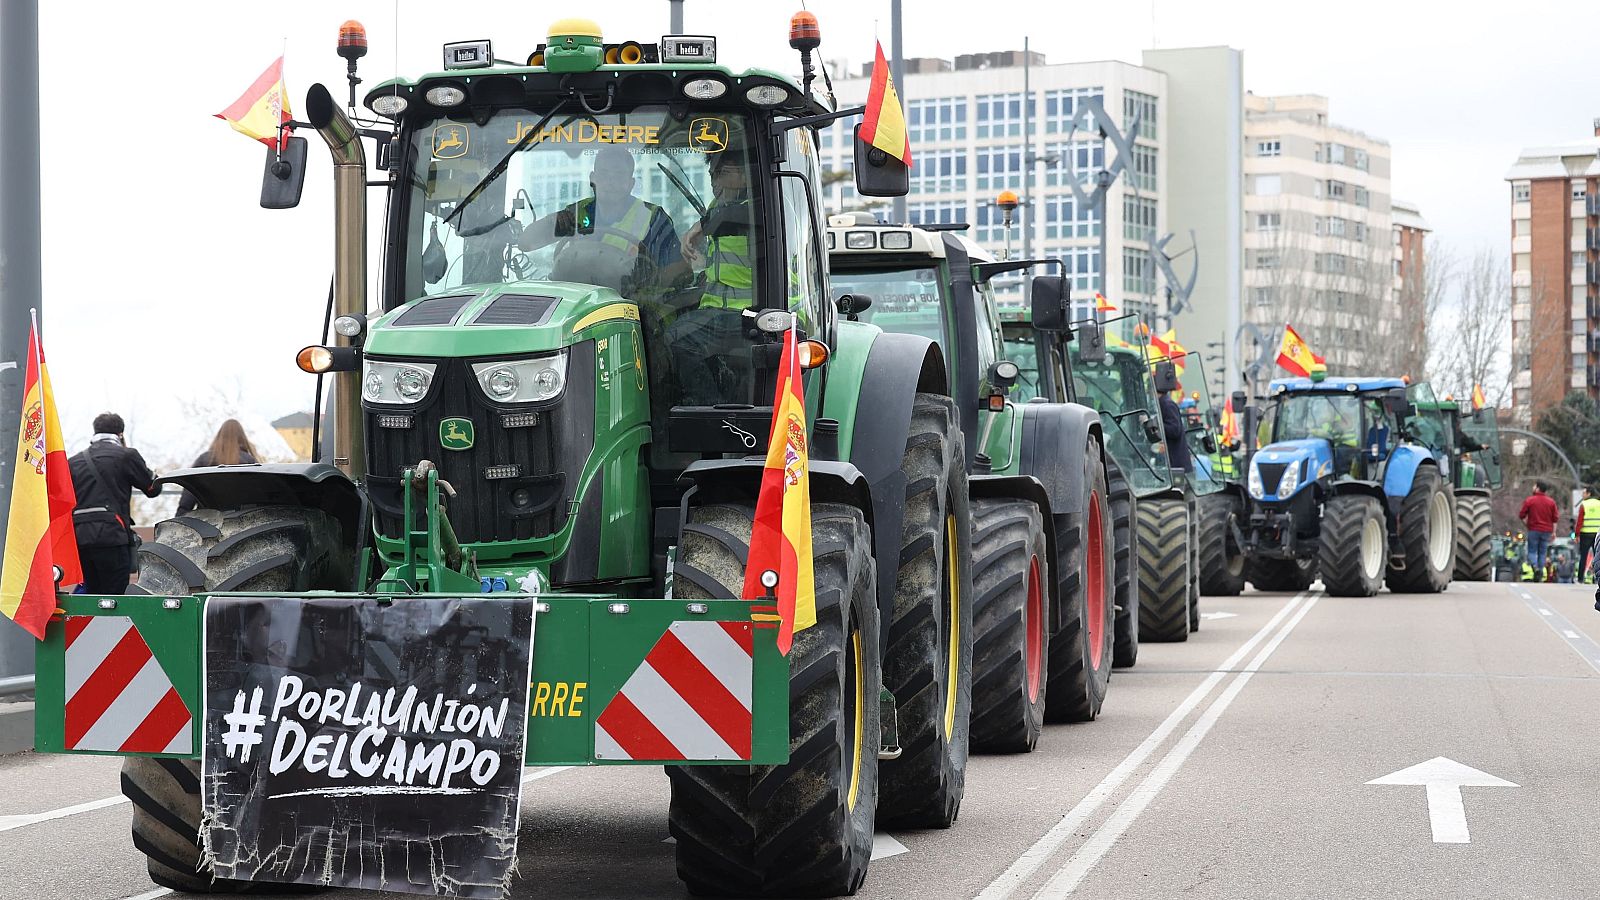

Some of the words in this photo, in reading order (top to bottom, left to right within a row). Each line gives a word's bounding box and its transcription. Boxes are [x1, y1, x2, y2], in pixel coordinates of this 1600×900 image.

[507, 121, 573, 144] JOHN
[578, 121, 660, 144] DEERE
[530, 682, 587, 717] RRE
